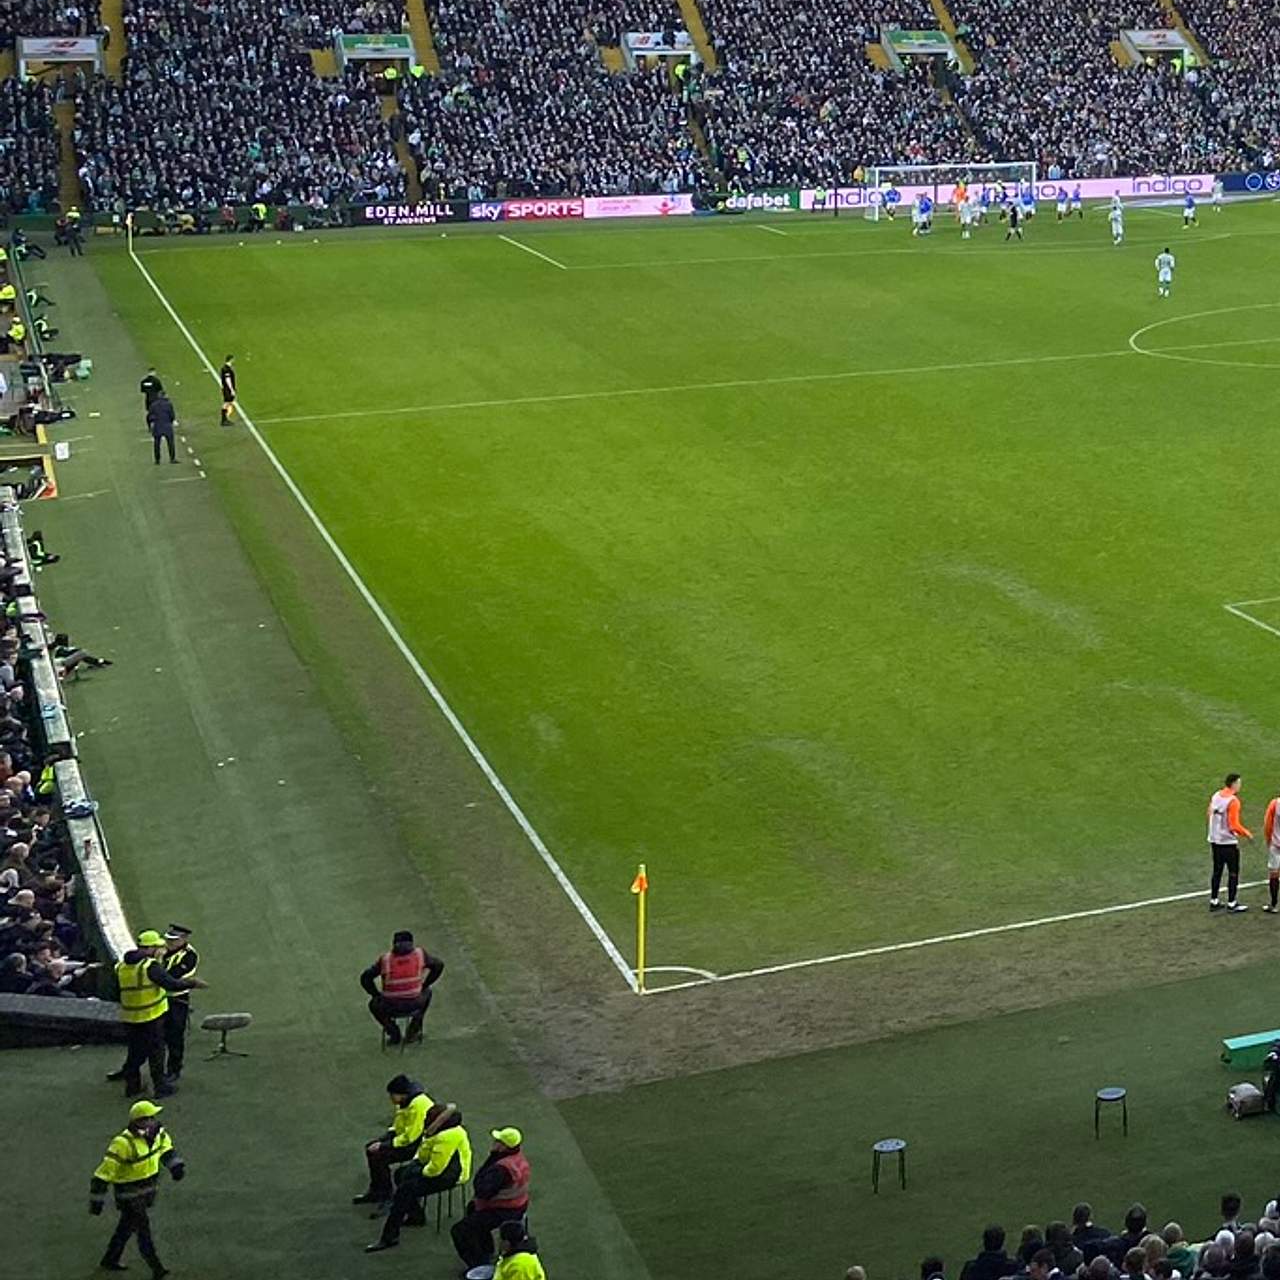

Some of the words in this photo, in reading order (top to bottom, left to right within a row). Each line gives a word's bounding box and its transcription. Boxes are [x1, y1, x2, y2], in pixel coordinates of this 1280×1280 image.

[1132, 176, 1203, 195] indigo
[726, 192, 790, 208] dafabet
[471, 204, 502, 220] sky
[509, 202, 583, 218] SPORTS
